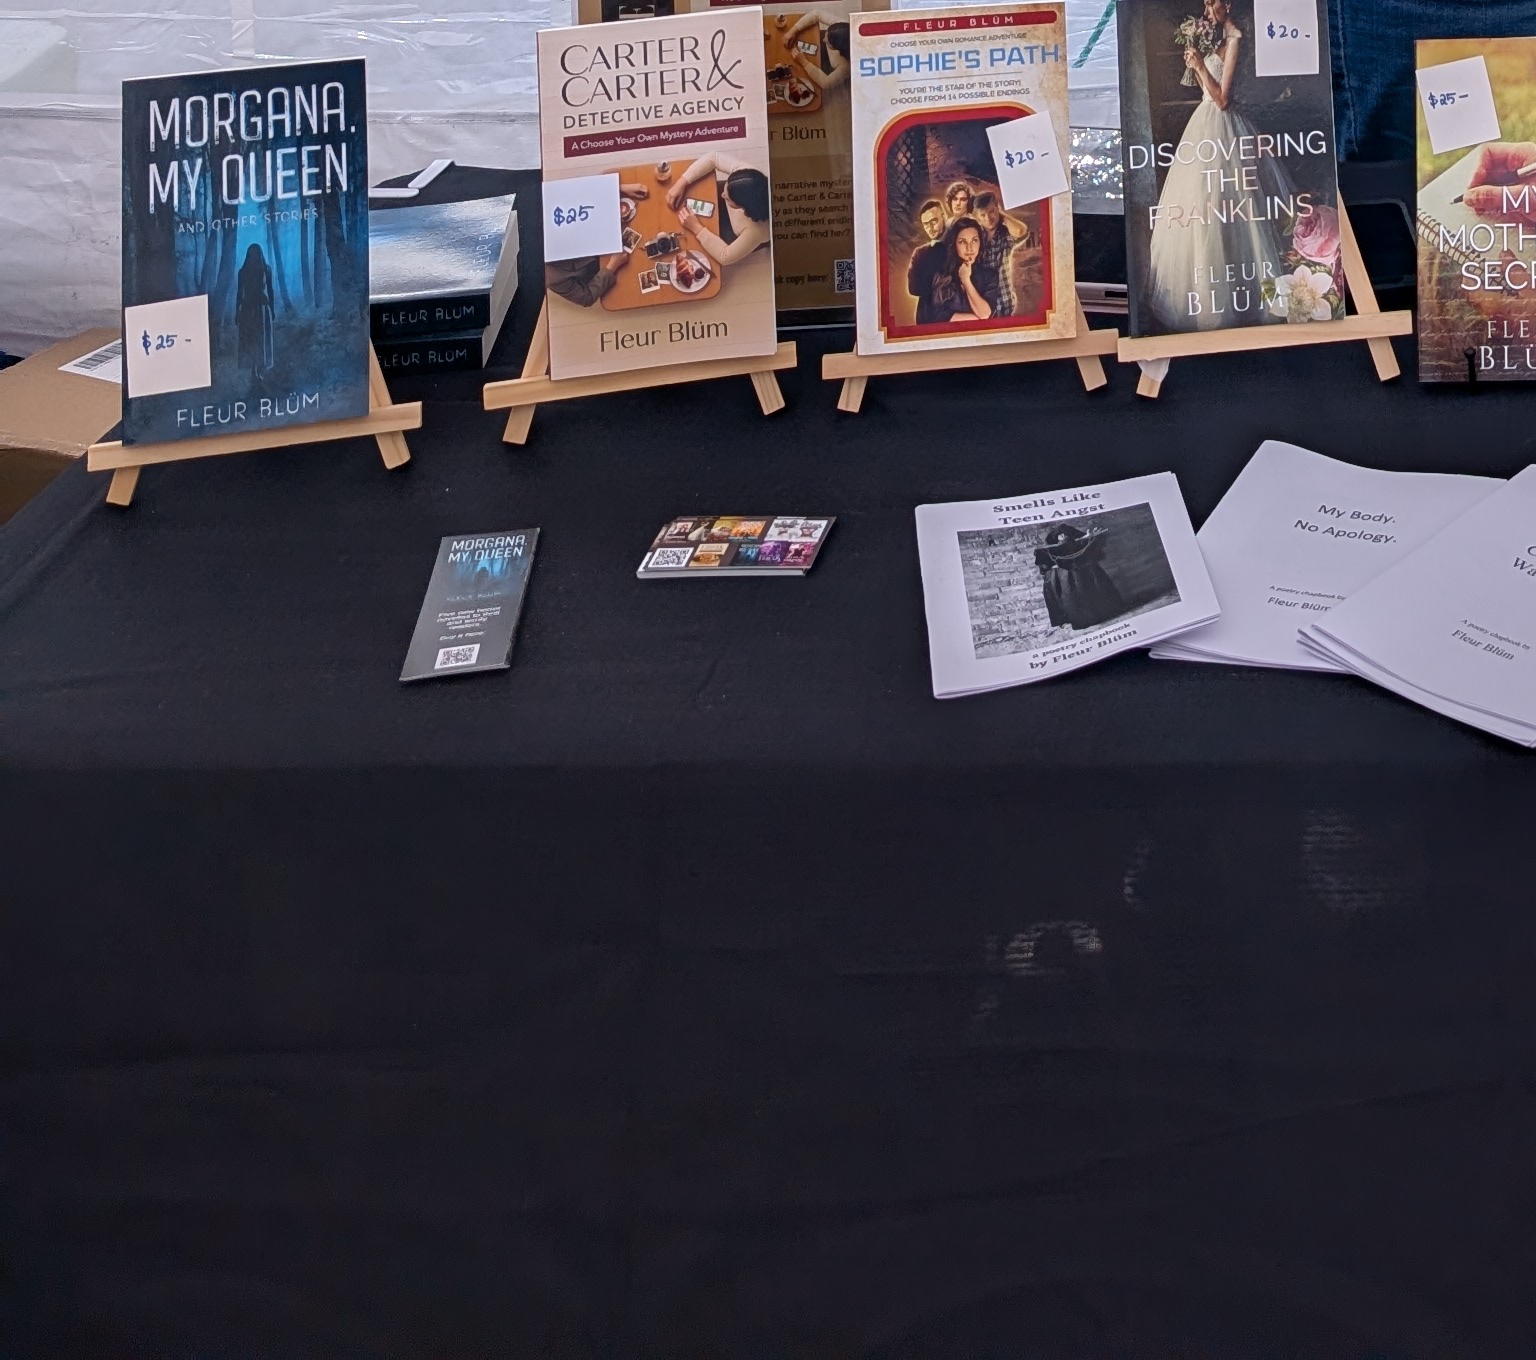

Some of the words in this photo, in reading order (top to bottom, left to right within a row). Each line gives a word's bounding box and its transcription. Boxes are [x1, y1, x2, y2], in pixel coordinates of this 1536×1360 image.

[904, 20, 957, 31] FLEUR
[970, 16, 1014, 27] BLÜM
[560, 36, 701, 76] CARTER
[707, 29, 744, 91] &
[860, 50, 980, 77] SOPHIE'S
[990, 44, 1060, 67] PATH
[562, 67, 702, 107] CARTER
[891, 96, 922, 105] CHOOSE
[924, 94, 946, 102] FROM
[959, 91, 995, 99] POSSIBLE
[997, 88, 1030, 96] ENDINGS
[150, 82, 356, 152] MORGANA.
[564, 105, 663, 129] DETECTIVE
[670, 96, 744, 117] AGENCY
[572, 142, 579, 150] A
[581, 139, 614, 149] Choose
[615, 136, 635, 145] Your
[638, 133, 658, 142] Own
[660, 130, 693, 141] Mystery
[695, 125, 738, 135] Adventure
[1129, 131, 1326, 170] DISCOVERING
[149, 157, 203, 213] MY
[222, 142, 348, 205] QUEEN
[1200, 166, 1258, 193] THE
[554, 205, 594, 226] $25
[1149, 193, 1313, 230] FRANKLINS
[1194, 261, 1275, 284] FLEUR
[1188, 285, 1286, 316] BLÜM
[600, 330, 661, 352] Fleur
[669, 321, 728, 343] Blüm
[177, 402, 246, 428] FLEUR
[260, 393, 319, 417] BLÜM
[993, 499, 1055, 512] Smells
[1062, 492, 1101, 503] Like
[998, 514, 1045, 525] Teen
[1051, 503, 1105, 518] Angst
[1318, 504, 1346, 519] My
[1350, 510, 1396, 525] Body.
[452, 535, 527, 551] MORGANA.
[1294, 520, 1319, 533] No
[1322, 526, 1397, 544] Apology.
[448, 551, 469, 563] MY
[475, 547, 523, 560] QUEEN
[1029, 659, 1048, 669] by
[1053, 646, 1093, 663] Fleur
[1097, 630, 1137, 648] Blüm
[1452, 629, 1482, 653] Fleur
[1483, 642, 1515, 661] Blüm
